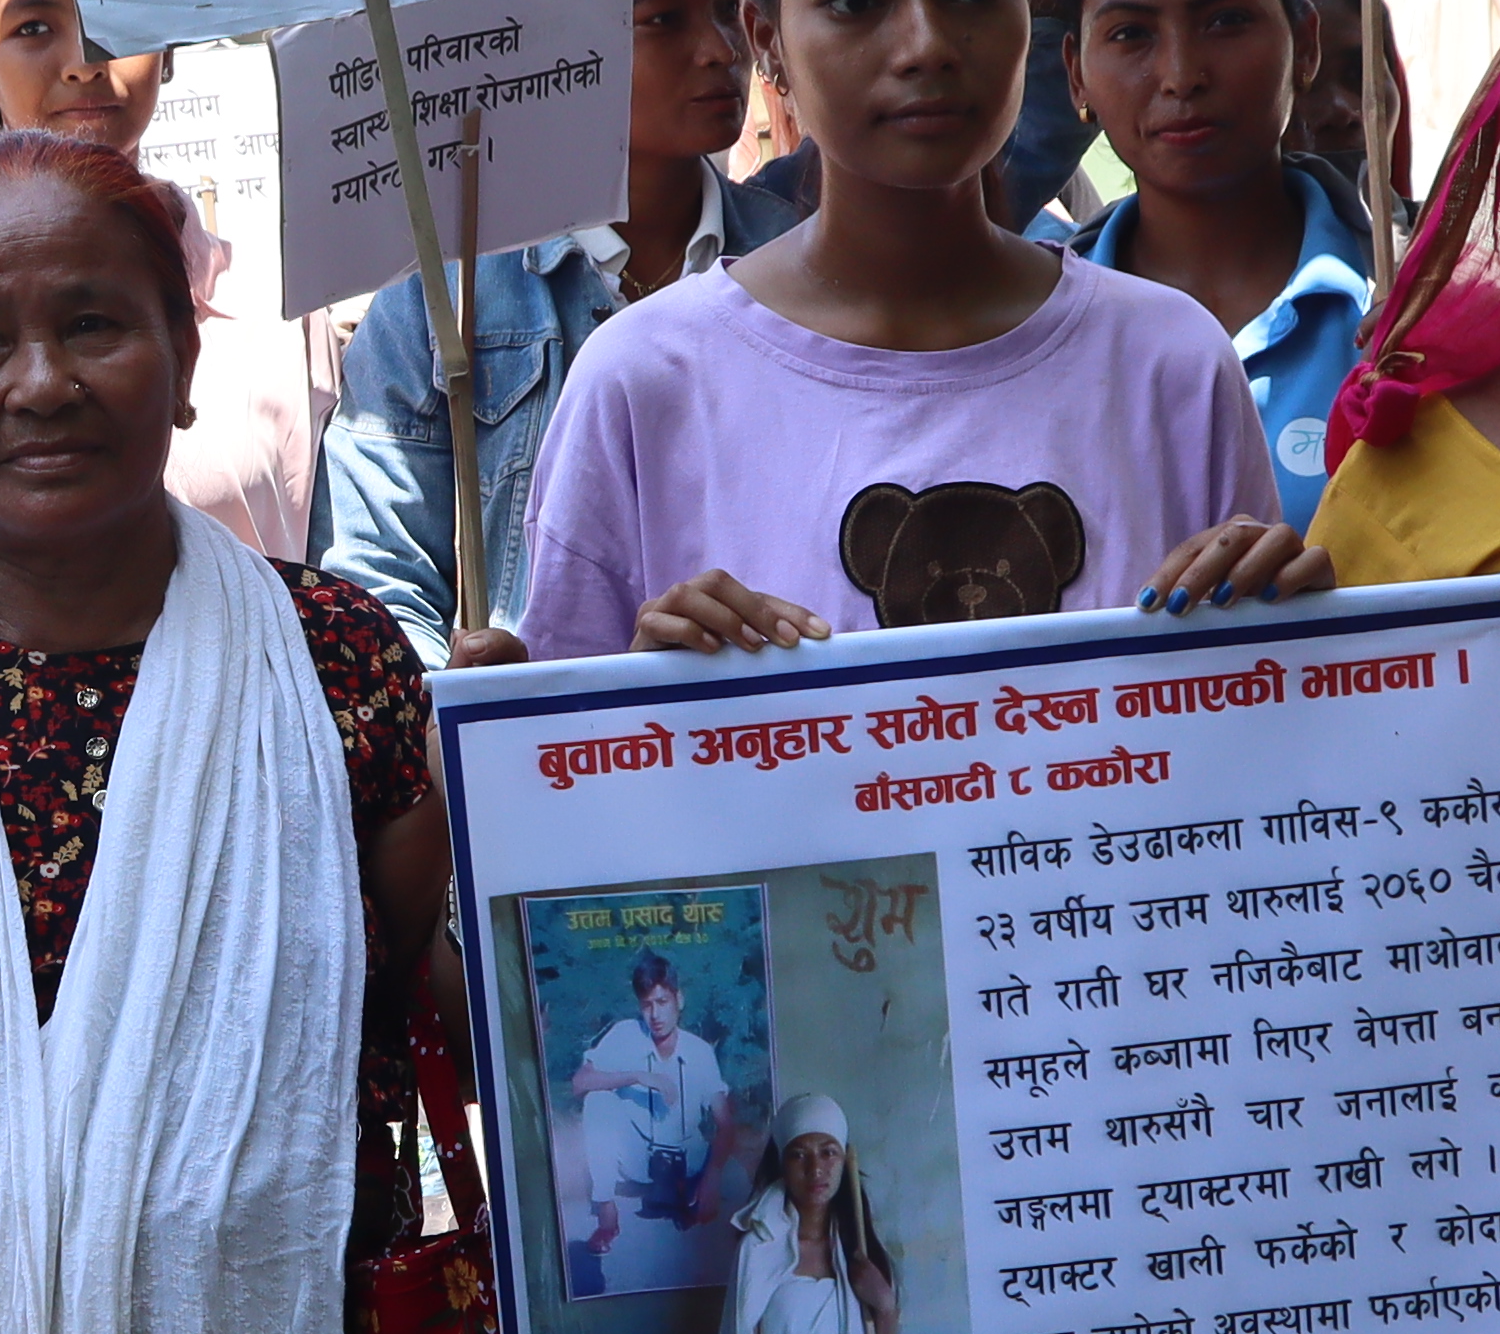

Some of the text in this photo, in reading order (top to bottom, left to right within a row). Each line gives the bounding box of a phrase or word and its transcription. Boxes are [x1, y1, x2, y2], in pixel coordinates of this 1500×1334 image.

[329, 17, 523, 100] पीडि परिवारको
[235, 177, 267, 200] गर
[539, 649, 1436, 789] बुवाको अनुहार समेत देख्न नपाएकी भावना
[857, 746, 1170, 812] बाँसगढी ८ ककौरा
[968, 831, 1071, 876] साविक
[1089, 820, 1243, 864] डेउढाकला
[1261, 800, 1402, 844] गाविस-९
[566, 908, 612, 930] उत्तम
[621, 904, 674, 929] प्रसाद
[977, 914, 1014, 950] २३
[1031, 895, 1113, 940] वर्षीय
[1130, 895, 1209, 930] उत्तम
[1228, 867, 1343, 919] थारुलाई
[1362, 869, 1450, 908] २०६०
[979, 975, 1030, 1018] गते
[1055, 966, 1120, 1010] राती
[1144, 969, 1188, 999] घर
[1211, 942, 1362, 992] नजिकैबाट
[984, 1039, 1089, 1097] समूहले
[1112, 1035, 1231, 1074] कब्जामा
[1254, 1019, 1332, 1062] लिएर
[1355, 1008, 1437, 1047] वेपत्ता
[990, 1123, 1071, 1159] उत्तम
[1106, 1094, 1214, 1146] थारुसँगै
[1245, 1098, 1304, 1129] चार
[1335, 1067, 1457, 1119] जनालाई
